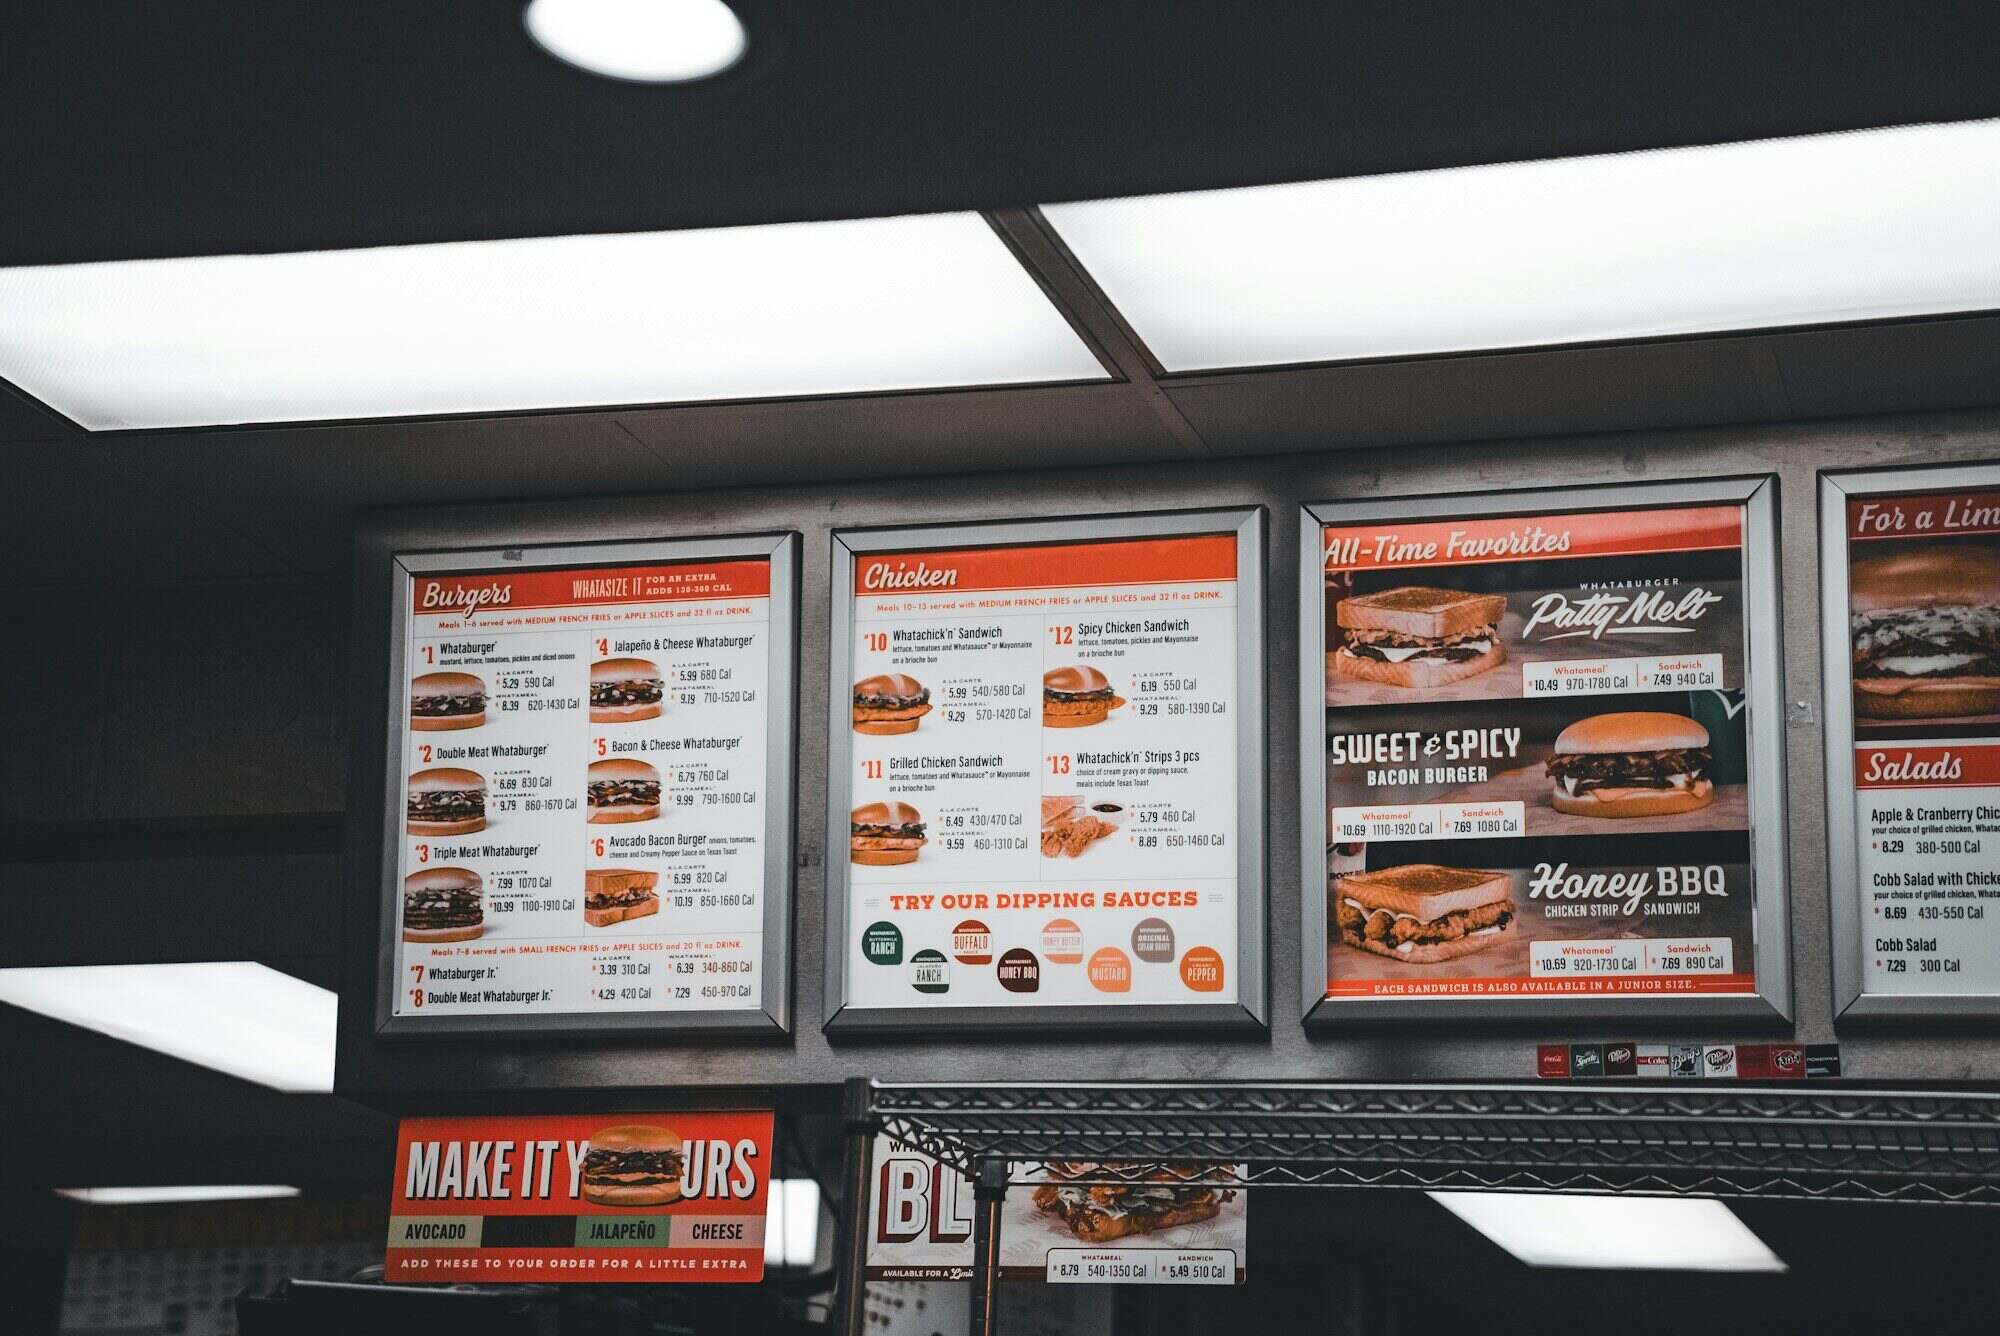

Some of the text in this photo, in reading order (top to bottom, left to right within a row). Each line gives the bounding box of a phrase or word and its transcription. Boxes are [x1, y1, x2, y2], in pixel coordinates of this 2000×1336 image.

[1858, 503, 1907, 533] For
[1915, 510, 1934, 529] a
[1324, 528, 1571, 565] All-Time Favorites
[685, 573, 716, 582] EXTRA
[865, 562, 958, 589] Chicken
[646, 587, 672, 595] ADDS
[1579, 578, 1680, 591] WHATABURGER
[422, 577, 642, 619] Burgers WHATASIZE IT
[526, 616, 555, 625] MEDIUM
[559, 615, 588, 623] FRENCH
[650, 610, 674, 618] SLICES
[1523, 588, 1723, 641] Patty Melt
[958, 627, 1002, 639] Sandwich
[1079, 620, 1189, 636] Spicy Chicken Sandwich
[614, 636, 753, 653] Jalapeño & Cheese Whataburger
[1165, 636, 1198, 644] Mayonnaise
[440, 641, 495, 655] Whataburger
[1658, 662, 1702, 670] Sandwich
[502, 698, 579, 711] 8.39 620-1430 Cal
[1140, 702, 1225, 715] 9.29 580-1390 Cal
[437, 745, 546, 759] Double Meat Whataburger
[612, 738, 740, 752] Bacon & Cheese Whataburger
[1332, 728, 1520, 765] SWEET & SPICY
[890, 756, 1003, 769] Grilled Chicken Sandwich
[1145, 751, 1200, 764] Strips 3 pcs
[1864, 752, 1962, 781] Salads
[1367, 767, 1488, 786] BACON BURGER
[1872, 808, 1902, 824] Apple
[1906, 809, 1913, 820] &
[1917, 808, 1973, 822] Cranberry
[1373, 822, 1415, 835] 1110-1920
[1419, 822, 1433, 834] Cal
[1477, 819, 1500, 832] 1080
[1503, 819, 1517, 831] Cal
[1872, 826, 1886, 835] your
[1889, 825, 1911, 833] choice
[1913, 825, 1919, 833] of
[1922, 825, 1943, 834] grilled
[610, 834, 707, 849] Avocado Bacon Burger
[1882, 840, 1980, 853] 8.29 380-500 Cal
[434, 846, 538, 860] Triple Meat Whataburger
[1874, 873, 1900, 886] Cobb
[1904, 873, 1934, 886] Salad
[1938, 872, 1963, 885] with
[1528, 862, 1728, 916] Honey BBQ
[890, 891, 1198, 910] TRY OUR DIPPING SAUCES
[1545, 902, 1700, 918] CHICKEN STRIP SANDWICH
[871, 943, 895, 954] RANCH
[955, 935, 988, 949] BUFFALO
[1876, 938, 1936, 951] Cobb Salad
[677, 961, 752, 973] 6.39 340-860 Cal
[1000, 966, 1037, 979] HONEY BBQ
[1092, 968, 1126, 980] MUSTARD
[429, 968, 485, 982] Whataburger
[916, 970, 941, 982] RANCH
[1188, 968, 1216, 981] PEPPER
[1374, 984, 1403, 993] EACH
[1407, 983, 1469, 993] SANDWICH
[1472, 983, 1483, 992] IS
[1488, 983, 1517, 992] ALSO
[1521, 982, 1586, 991] AVAILABLE
[1590, 981, 1602, 990] IN
[1606, 980, 1615, 990] A
[1618, 980, 1661, 990] JUNIOR
[428, 990, 539, 1004] Double Meat Whataburger
[404, 1139, 758, 1199] MAKE IT YURS
[405, 1224, 466, 1240] AVOCADO
[590, 1220, 655, 1239] JALAPEÑO
[692, 1223, 743, 1239] CHEESE
[401, 1259, 748, 1269] ADD THESE TO YOUR ORDER FOR A LITTLE EXTRA
[1061, 1264, 1146, 1277] 8.79 540-1350 Cal
